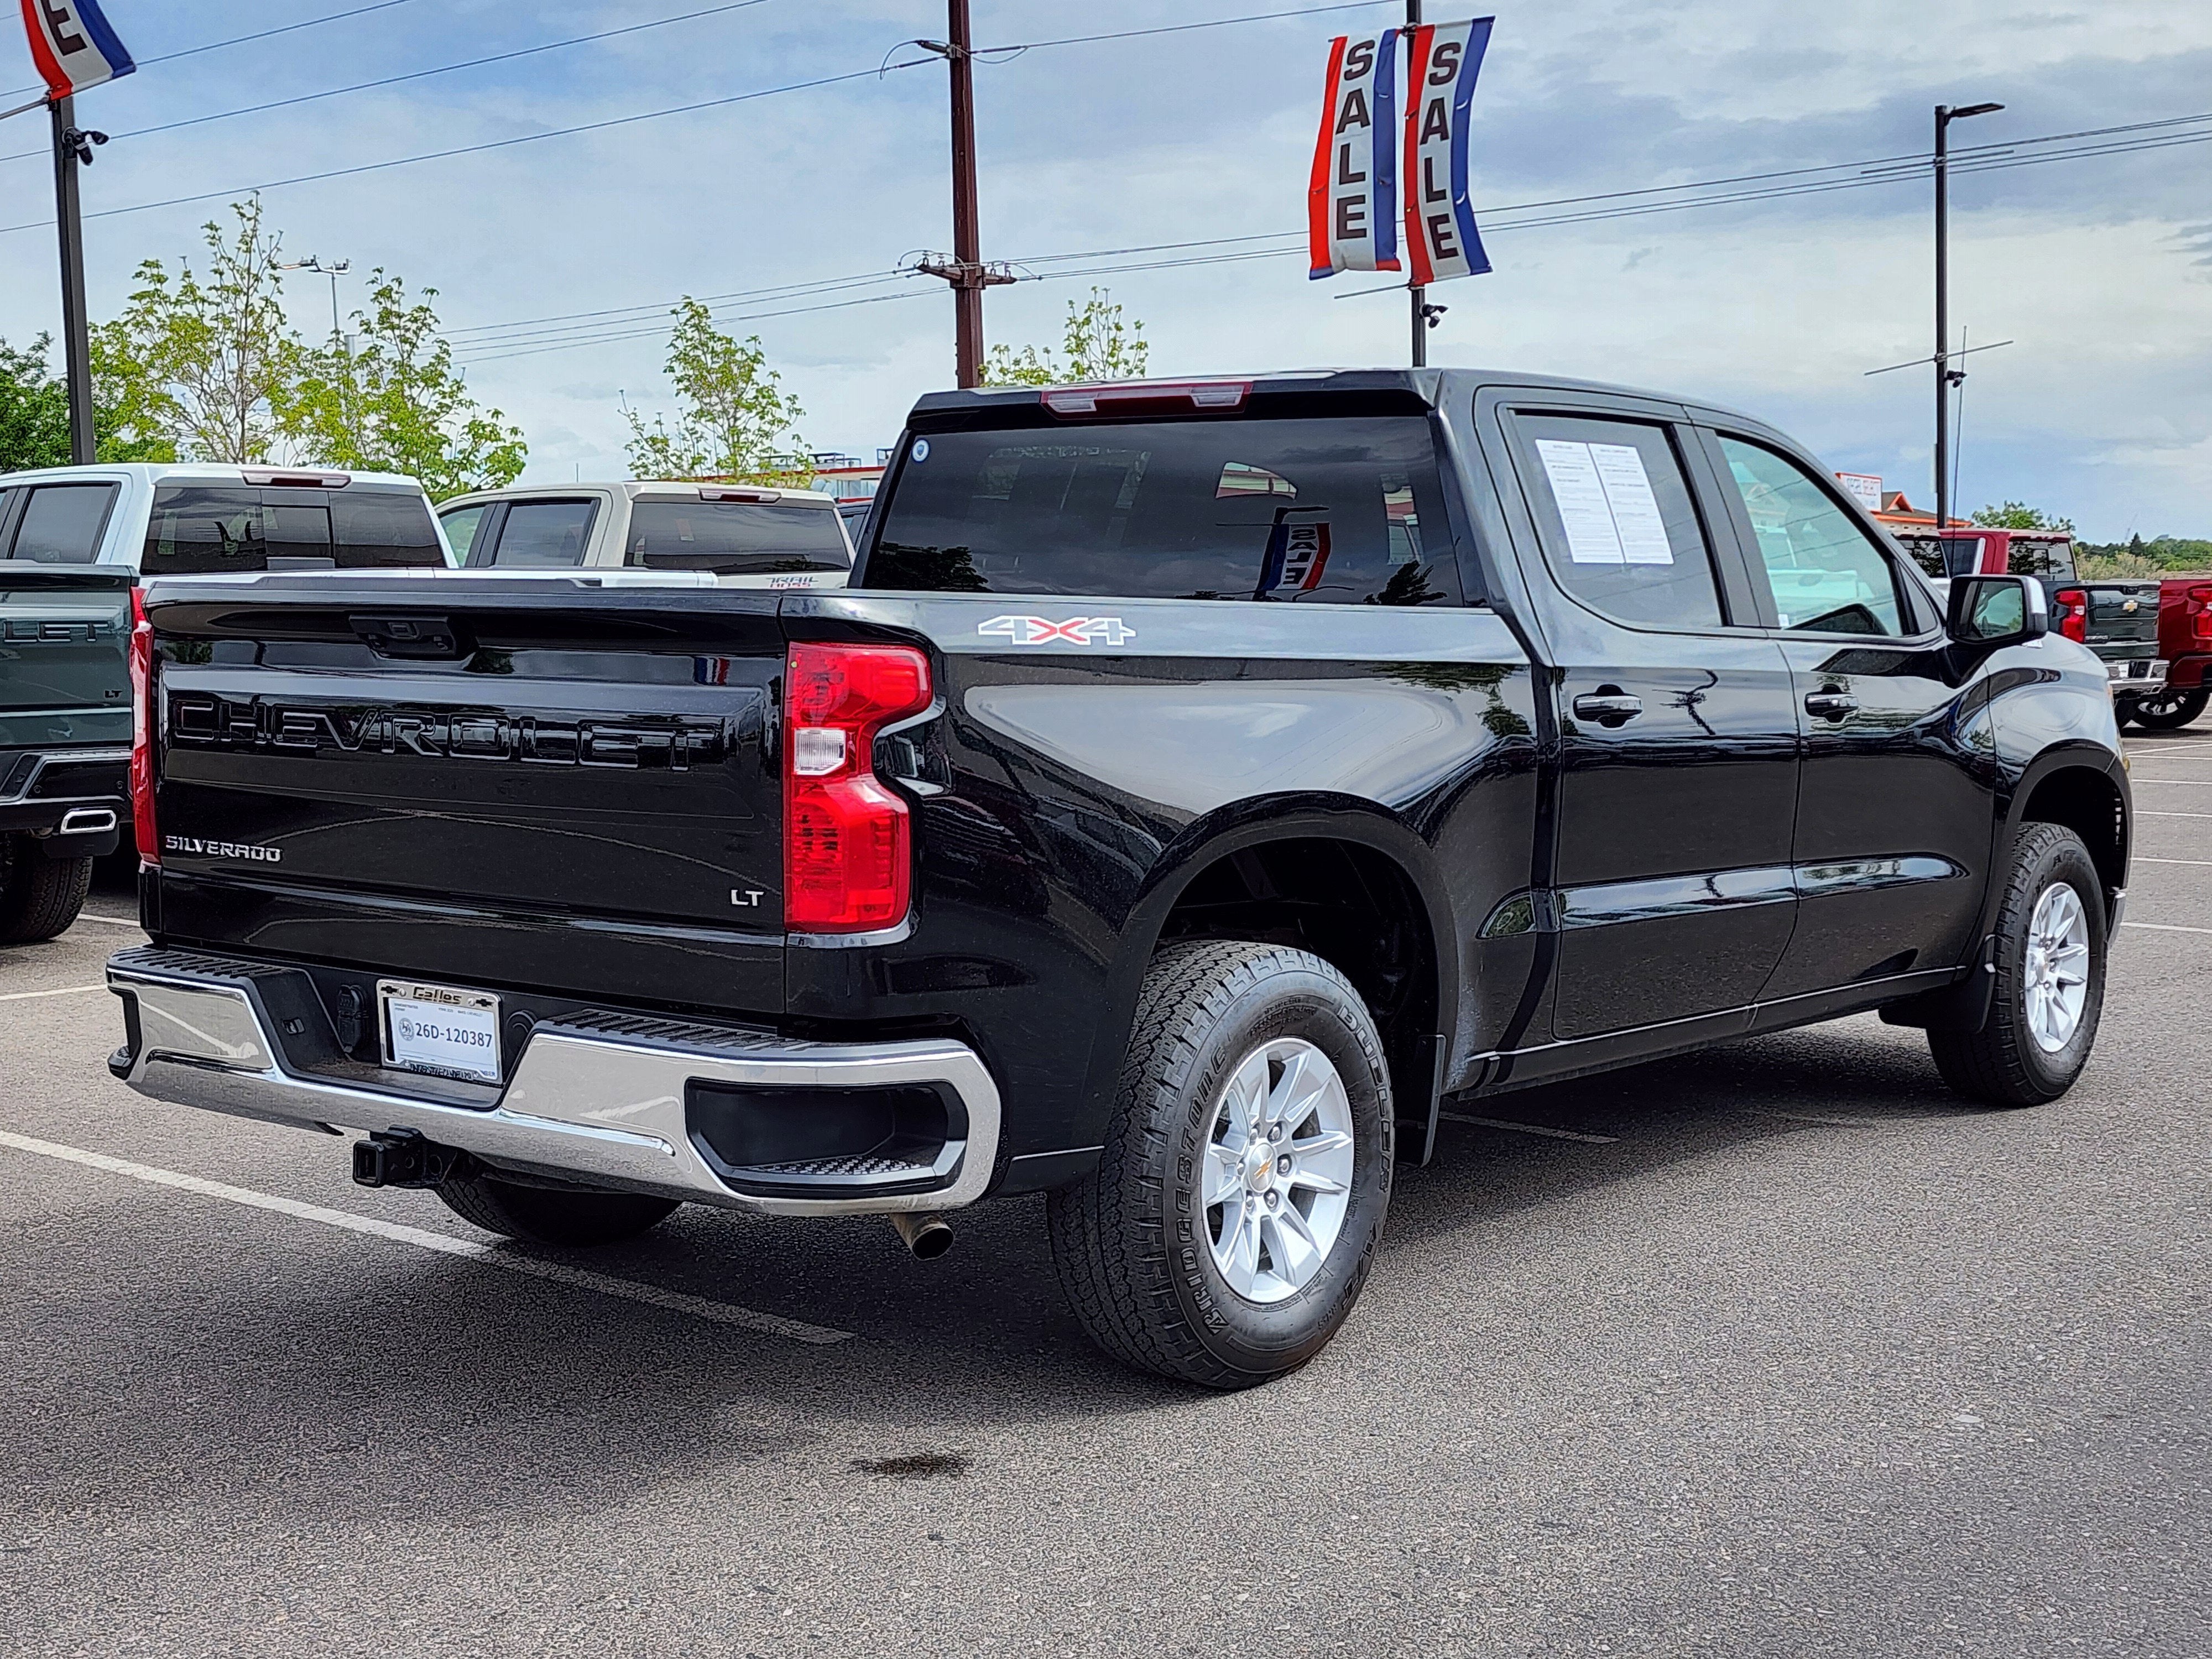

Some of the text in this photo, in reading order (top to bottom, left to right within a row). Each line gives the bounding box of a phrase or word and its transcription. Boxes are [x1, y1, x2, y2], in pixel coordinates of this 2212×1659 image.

[1335, 39, 1376, 241] SALE
[1420, 41, 1462, 260] SALE
[104, 690, 123, 698] LT
[173, 698, 721, 772] CHEVROLET
[165, 835, 281, 862] SILVERADO
[731, 889, 765, 906] LT
[415, 1022, 493, 1048] 26D-120387
[1175, 1045, 1230, 1336] BRIDGESTONE
